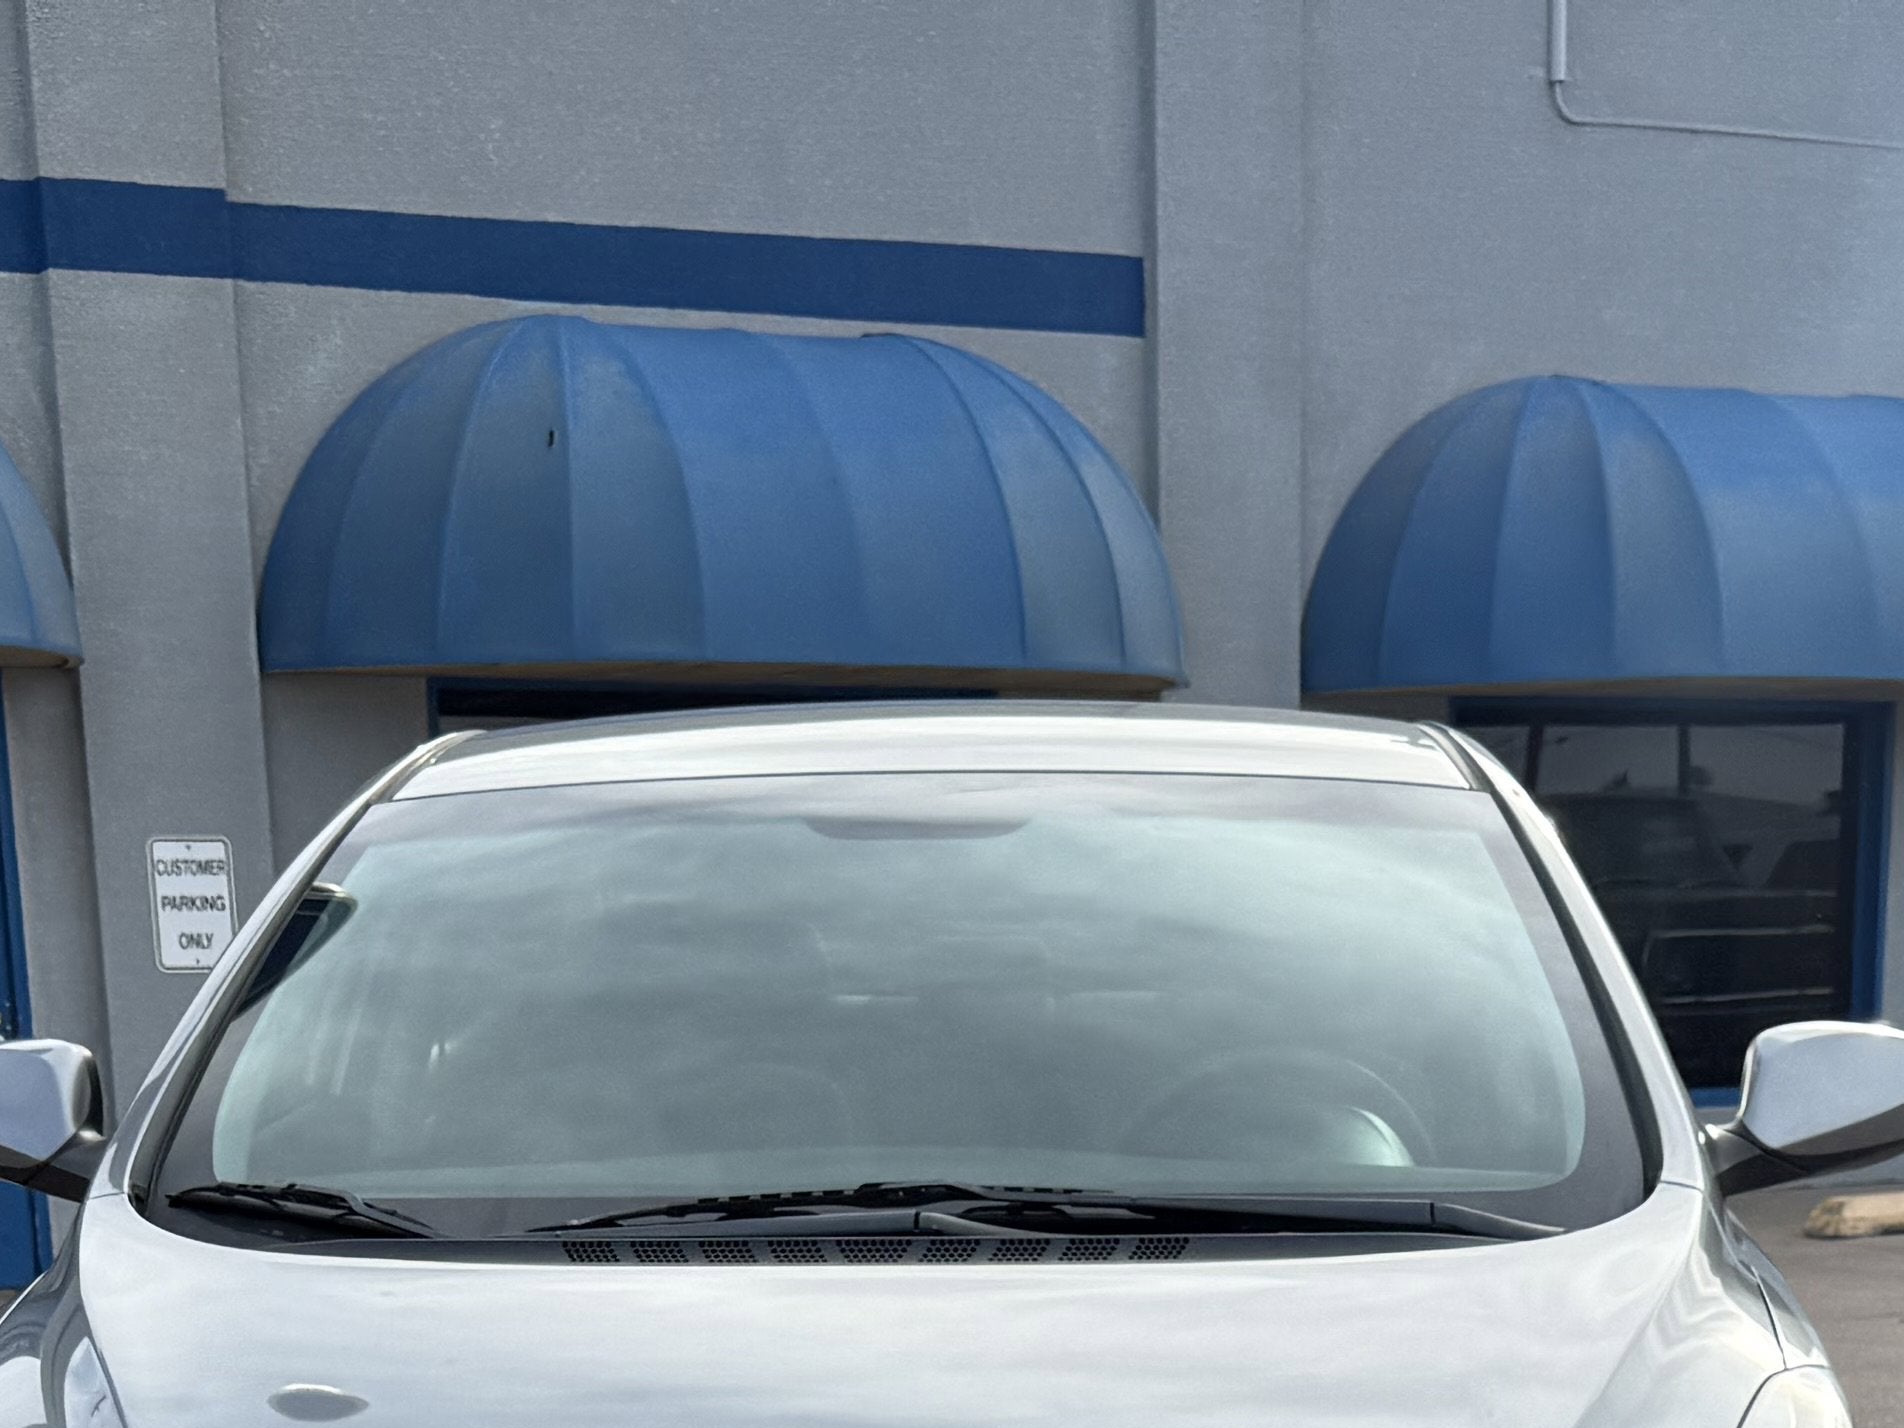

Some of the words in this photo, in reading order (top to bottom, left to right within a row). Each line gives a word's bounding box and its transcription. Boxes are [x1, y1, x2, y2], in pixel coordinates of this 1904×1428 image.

[156, 859, 226, 877] CUSTOMER
[161, 895, 227, 912] PARKING
[178, 932, 215, 950] ONLY
